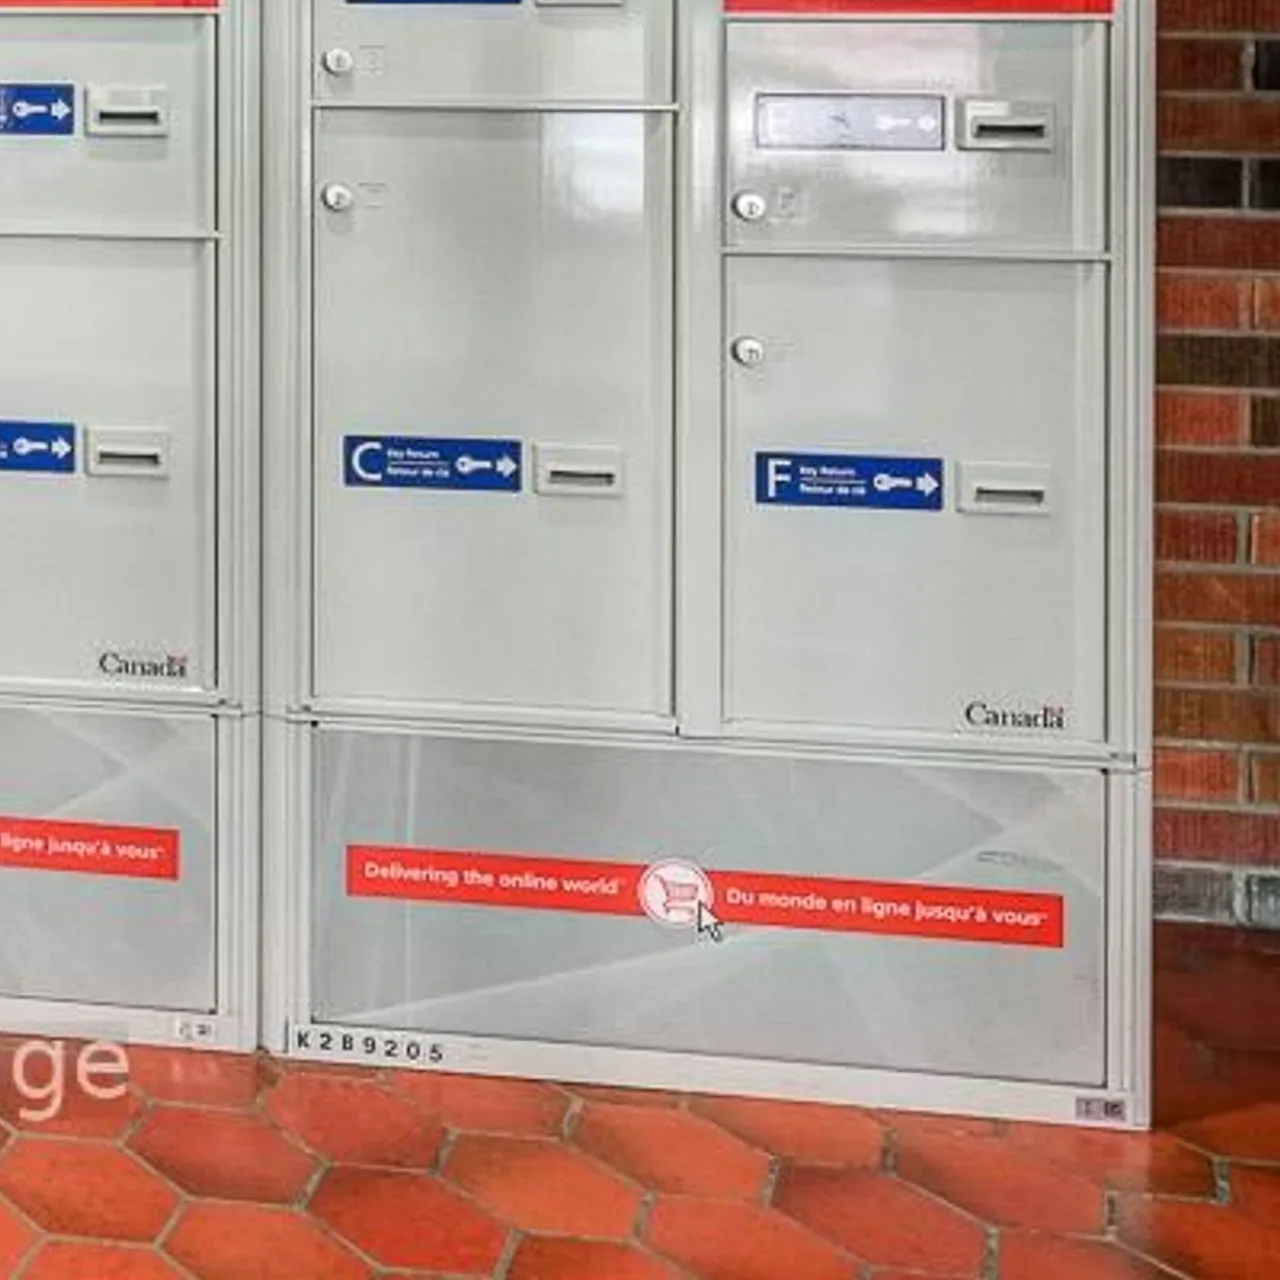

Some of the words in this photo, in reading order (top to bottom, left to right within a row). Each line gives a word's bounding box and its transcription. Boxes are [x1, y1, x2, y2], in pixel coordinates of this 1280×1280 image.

[351, 441, 382, 480] C
[767, 458, 791, 497] F
[965, 701, 1064, 728] Canada
[1, 831, 44, 854] ligne
[365, 861, 459, 888] Delivering
[463, 868, 494, 888] the
[499, 870, 558, 892] online
[726, 889, 754, 906] Du
[759, 890, 827, 911] monde
[831, 896, 857, 913] en
[861, 895, 911, 919] ligne
